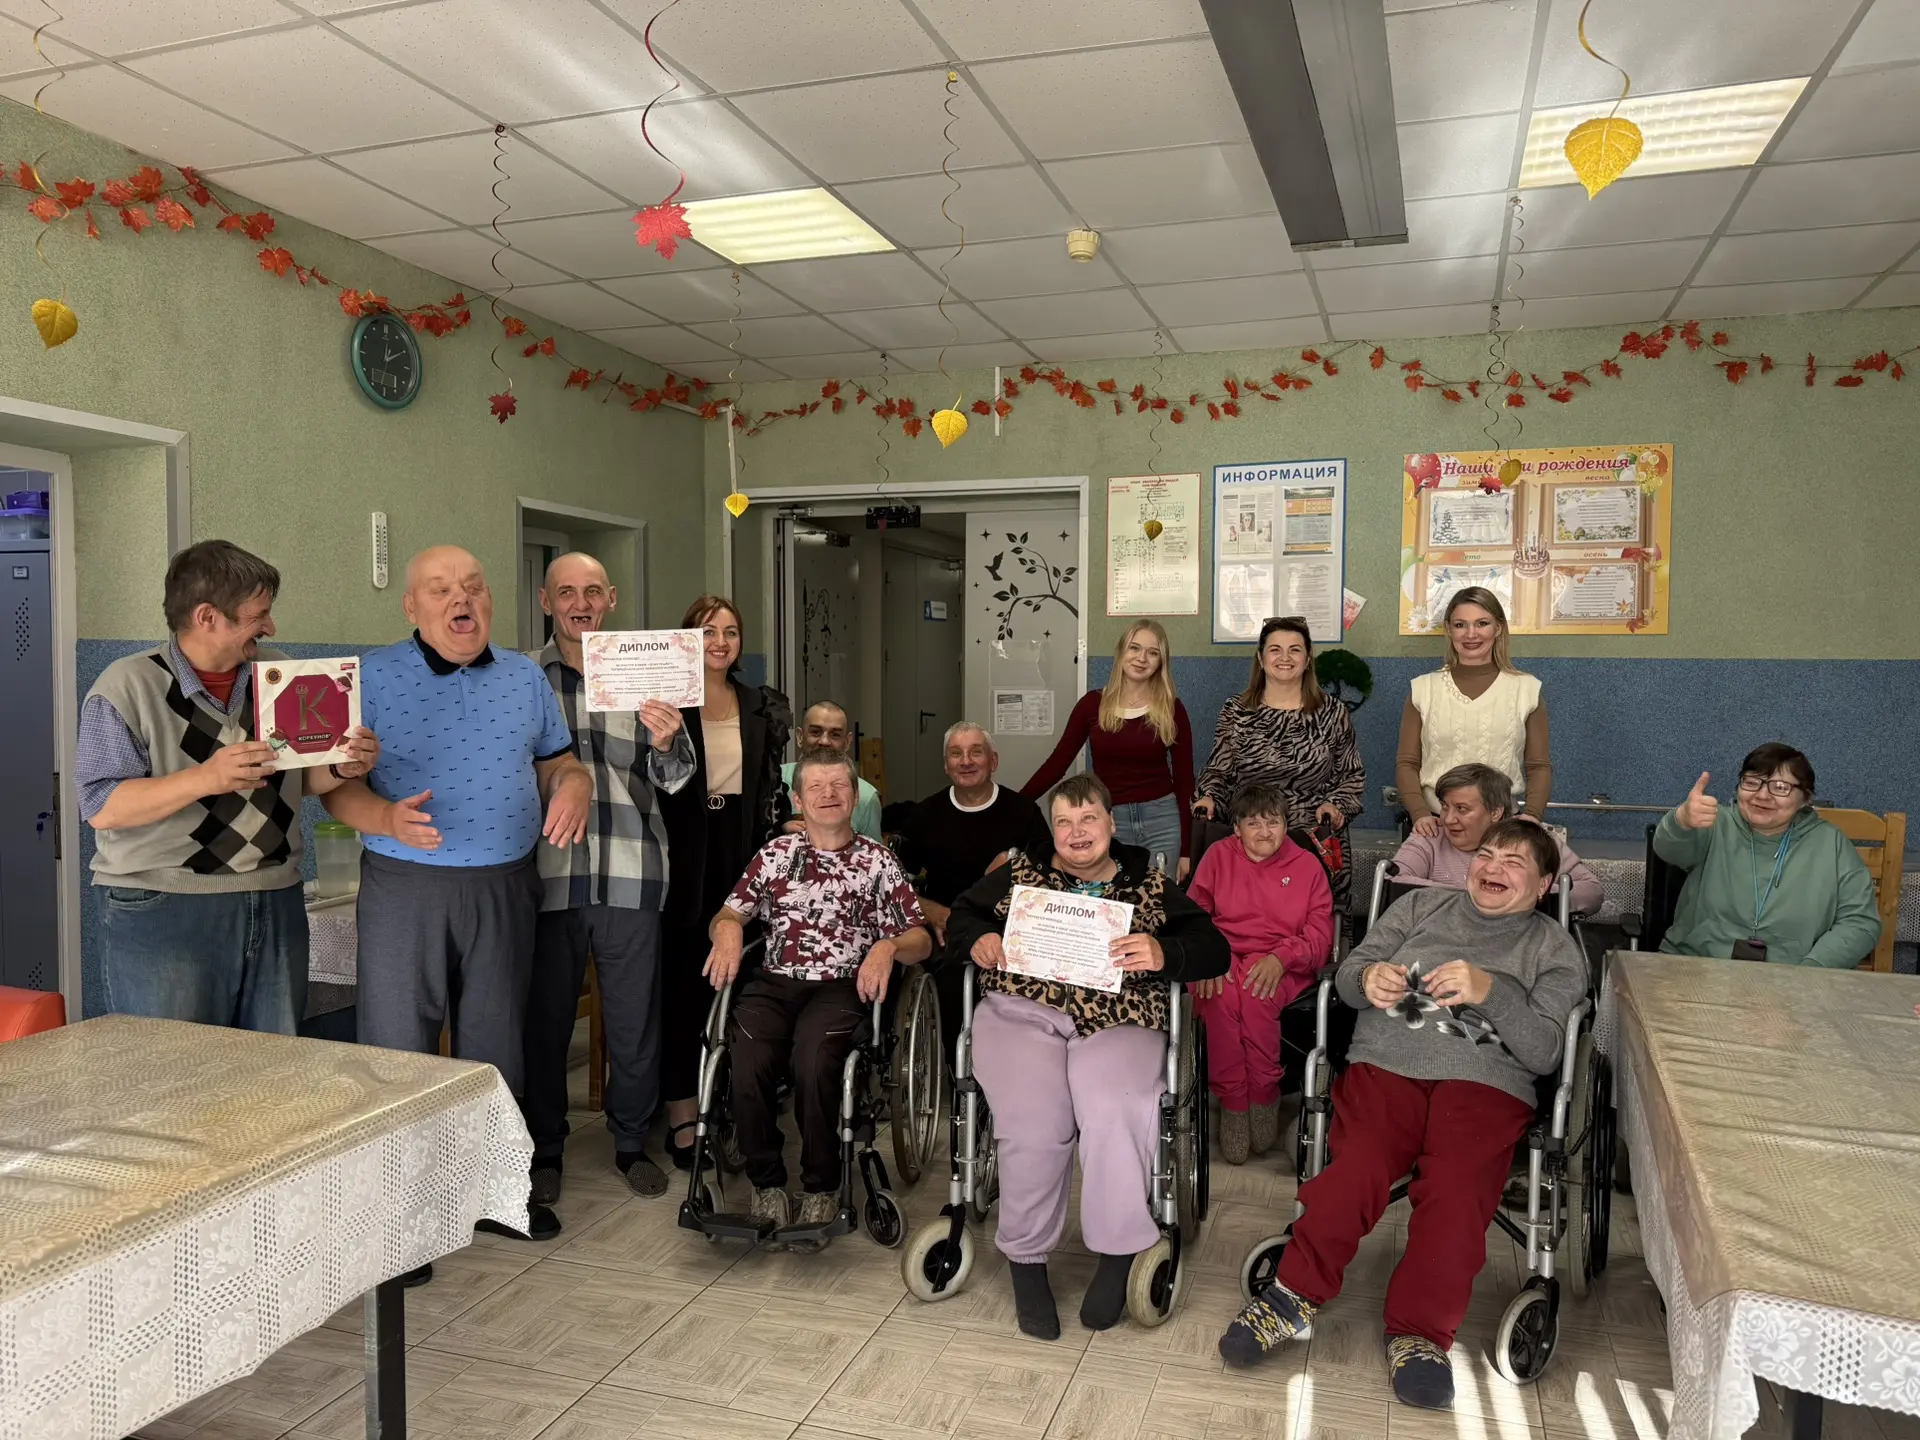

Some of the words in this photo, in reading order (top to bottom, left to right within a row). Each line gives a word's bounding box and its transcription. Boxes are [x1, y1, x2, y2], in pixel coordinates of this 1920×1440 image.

[1443, 462, 1494, 475] Наши
[1537, 455, 1630, 475] рождения
[1222, 466, 1337, 483] ИНФОРМАЦИЯ
[618, 641, 670, 654] ДИПЛОМ
[1044, 902, 1096, 919] ДИПЛОМ
